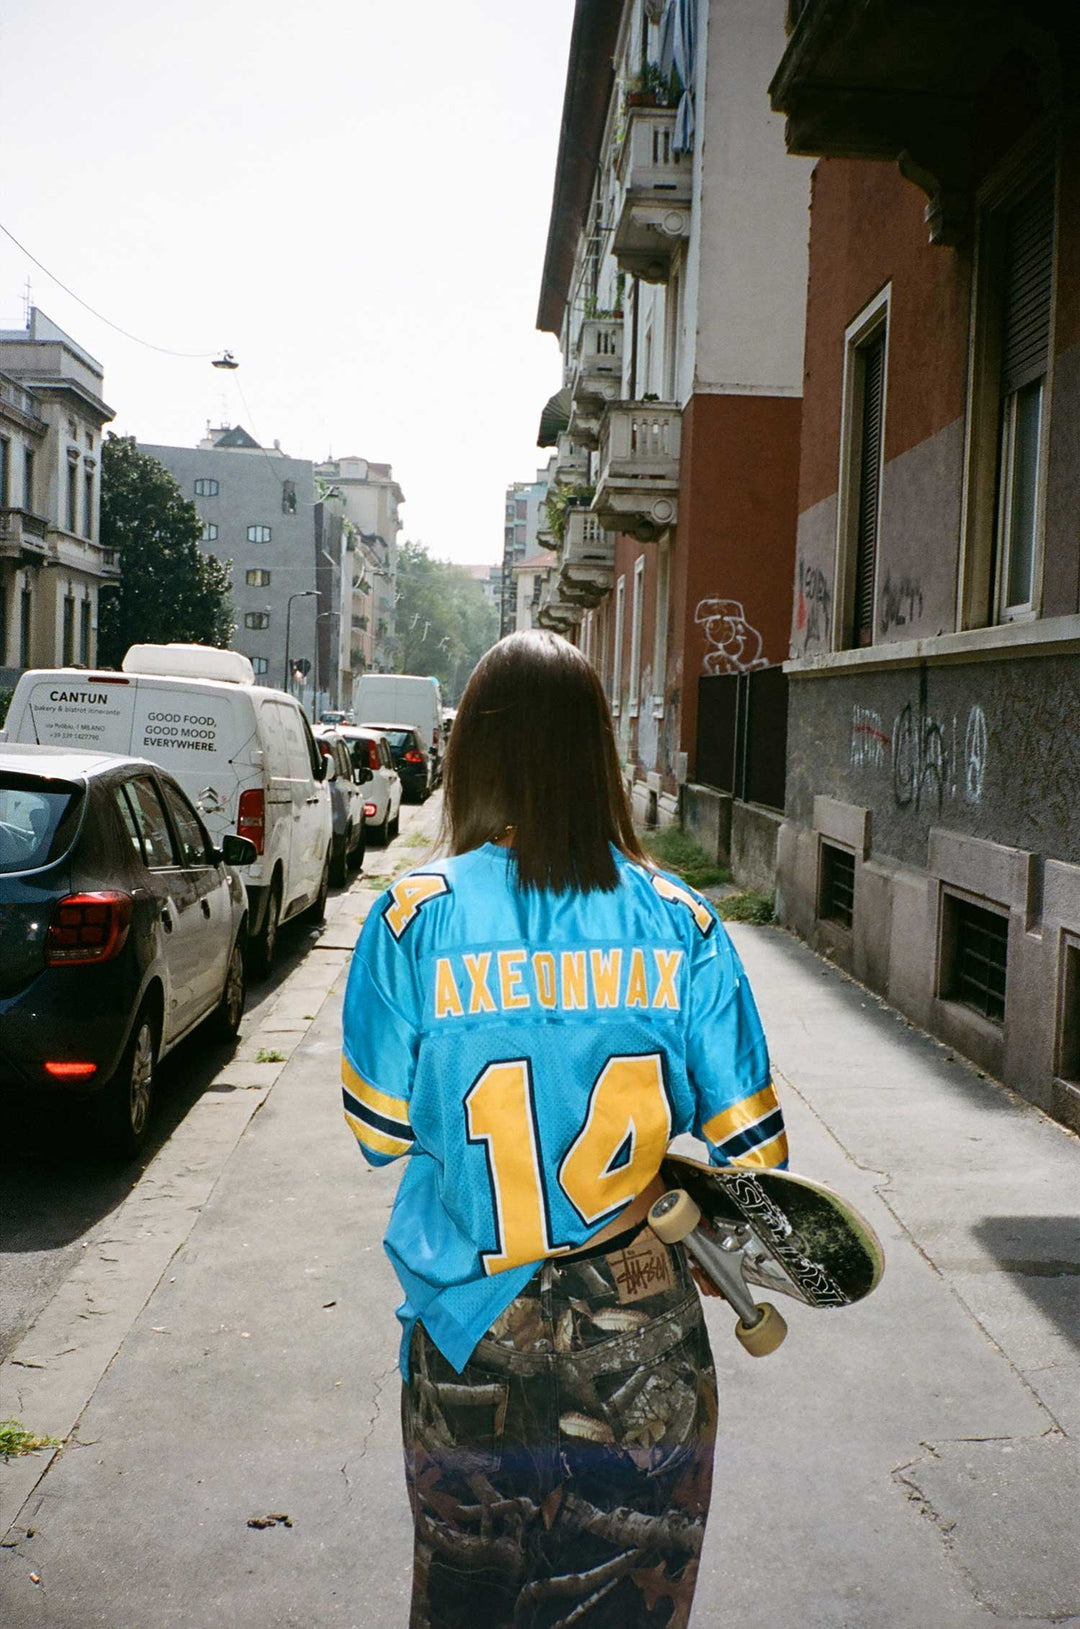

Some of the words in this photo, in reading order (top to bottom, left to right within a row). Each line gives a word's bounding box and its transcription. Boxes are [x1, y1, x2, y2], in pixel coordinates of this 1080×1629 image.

[50, 690, 108, 705] CANTUN
[34, 704, 56, 714] bakery
[65, 706, 87, 714] bistrot
[148, 712, 181, 723] GOOD
[183, 715, 217, 728] FOOD,
[80, 724, 106, 733] MILANO
[145, 725, 178, 736] GOOD
[180, 728, 216, 740] MOOD
[143, 737, 217, 752] EVERYWHERE.
[434, 948, 681, 1017] AXEONWAX
[463, 1050, 675, 1279] 14
